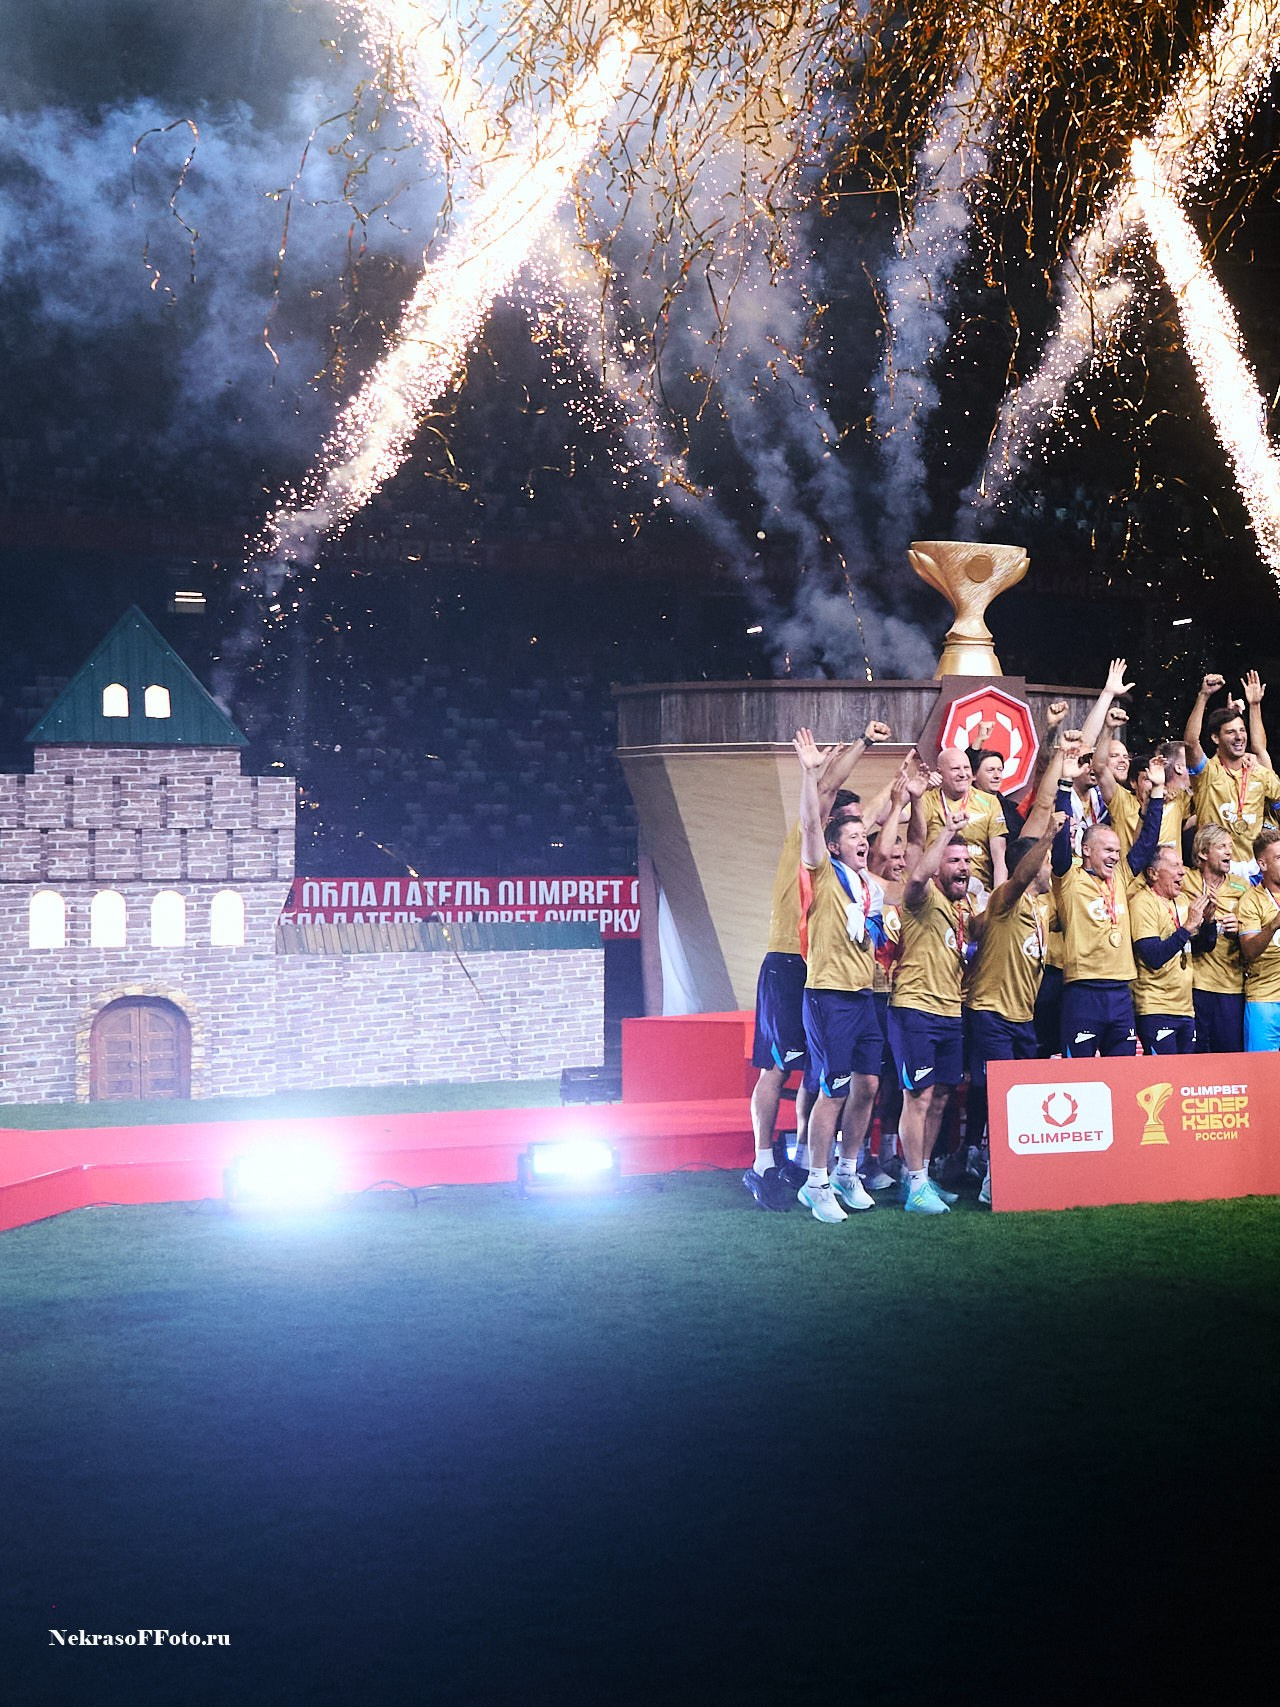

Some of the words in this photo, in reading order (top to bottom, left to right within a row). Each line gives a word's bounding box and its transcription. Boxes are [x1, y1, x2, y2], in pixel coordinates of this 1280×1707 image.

[1180, 1084, 1248, 1097] OLIMPBET
[1181, 1096, 1249, 1114] СУПЕР
[1181, 1112, 1250, 1131] КУБОК
[1017, 1130, 1104, 1146] OLIMPBET
[1195, 1130, 1238, 1142] РОССИИ
